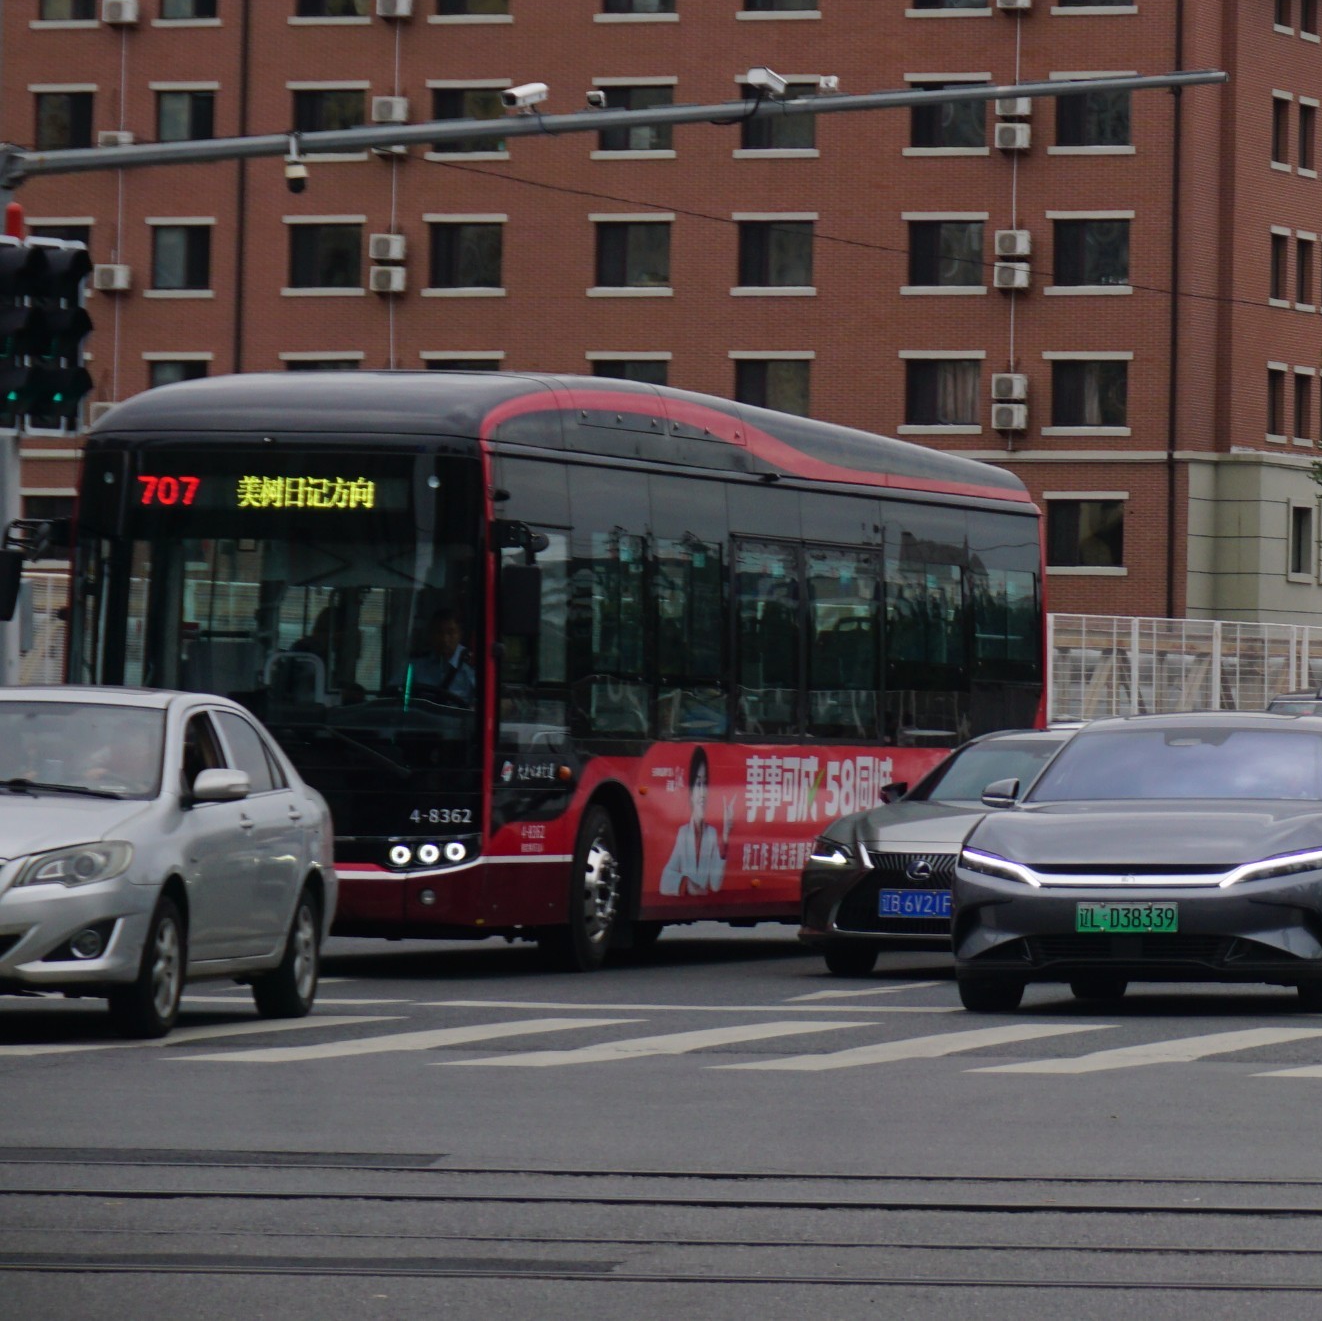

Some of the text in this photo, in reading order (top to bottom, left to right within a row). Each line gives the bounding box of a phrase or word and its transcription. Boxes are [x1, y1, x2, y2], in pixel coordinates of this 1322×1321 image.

[137, 476, 200, 506] 707
[236, 475, 376, 509] 美树日记方向
[745, 755, 823, 823] 事事可成
[409, 808, 473, 824] 4-8362
